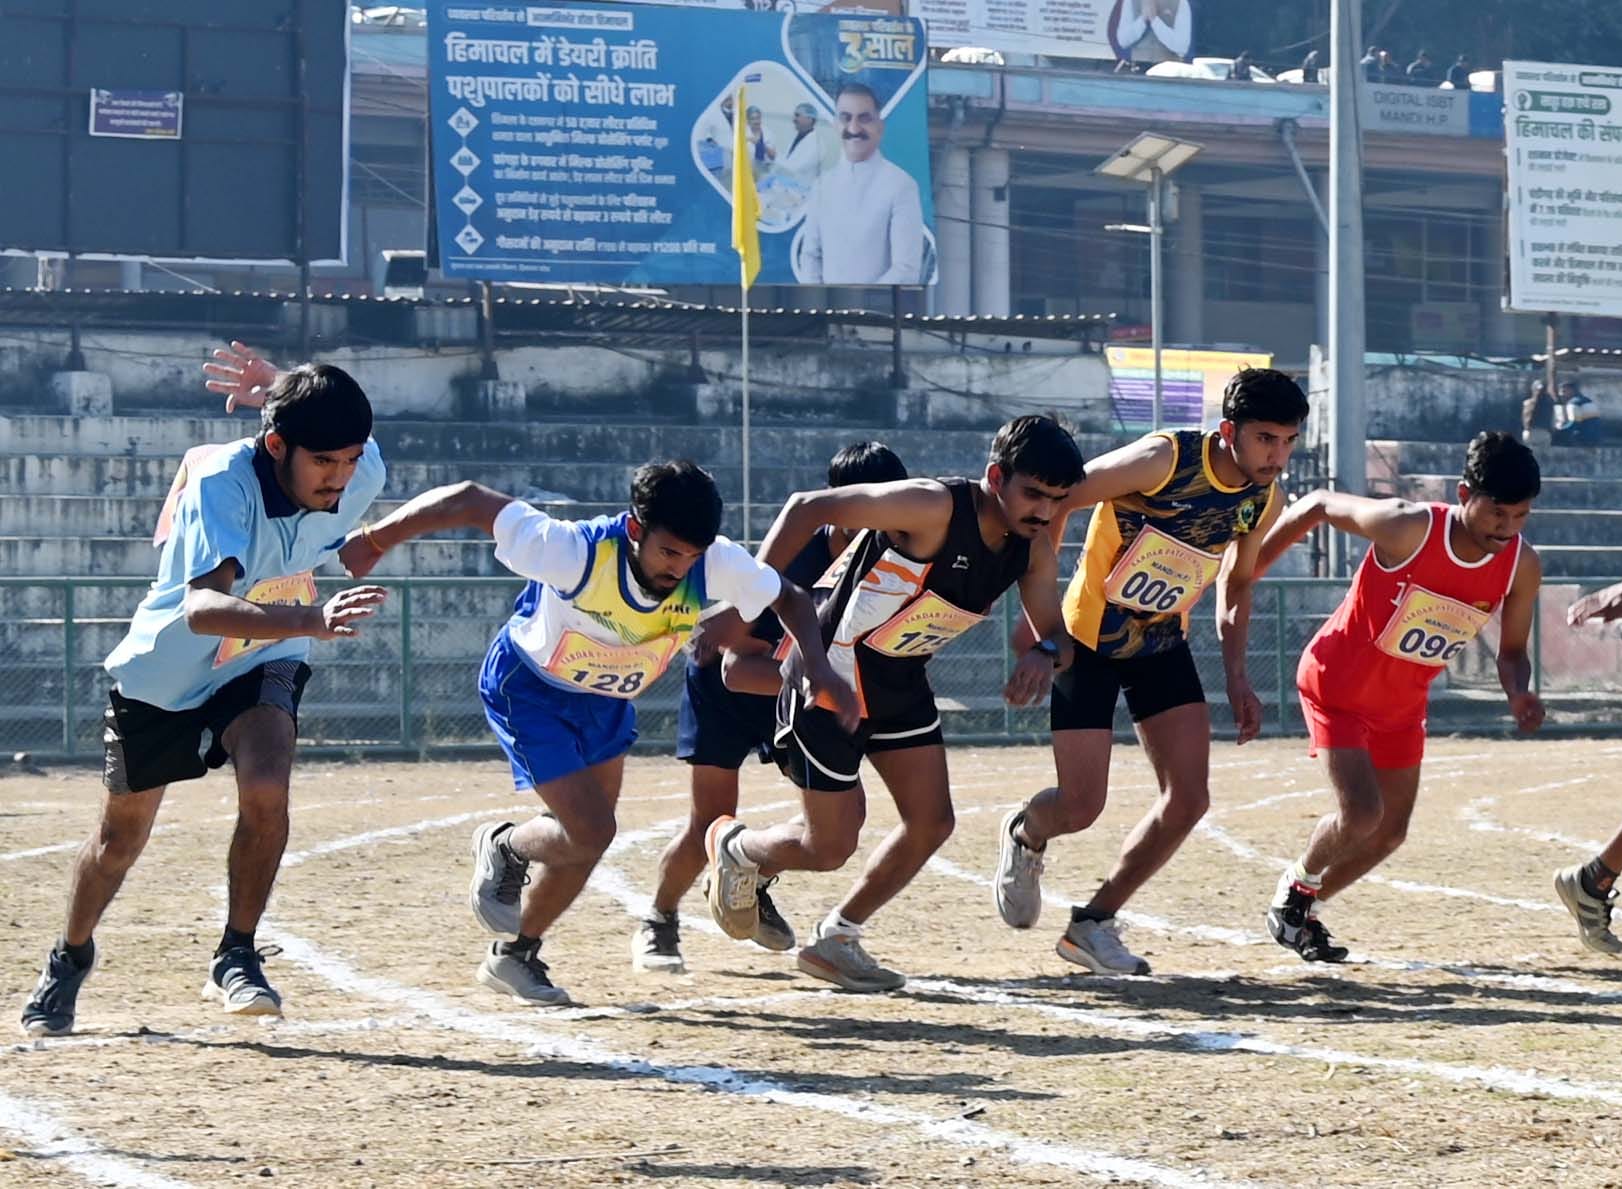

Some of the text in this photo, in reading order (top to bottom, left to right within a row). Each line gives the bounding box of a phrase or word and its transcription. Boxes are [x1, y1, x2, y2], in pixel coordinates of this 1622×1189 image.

[444, 32, 658, 70] हिमाचल में डेयरी क्रांति
[864, 34, 917, 62] साल
[446, 72, 676, 107] पशुपालकों को सीधे लाभ
[1515, 115, 1574, 140] हिमाचल
[1577, 118, 1596, 141] की
[1121, 571, 1185, 611] 006
[1399, 627, 1467, 660] 096
[569, 668, 645, 694] 128
